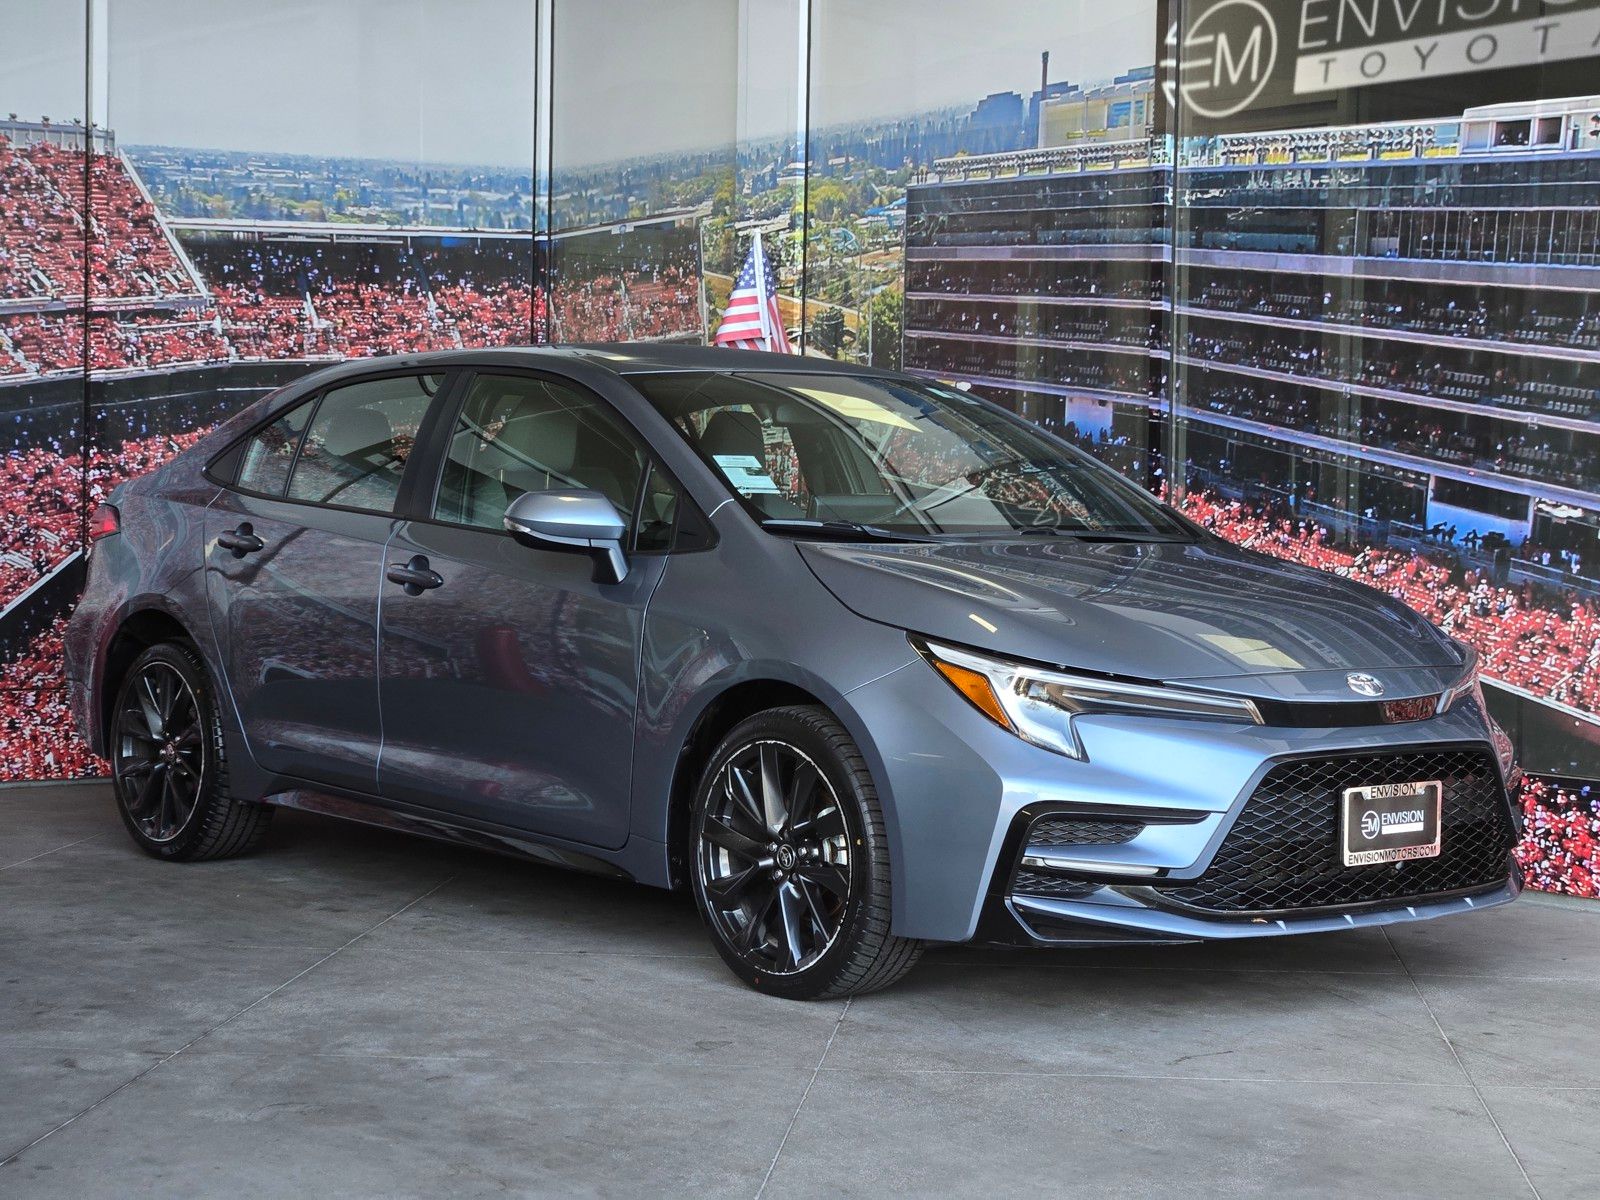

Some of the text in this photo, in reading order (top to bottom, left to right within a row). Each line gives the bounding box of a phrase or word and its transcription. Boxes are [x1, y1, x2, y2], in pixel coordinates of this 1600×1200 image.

[1298, 0, 1580, 49] ENVI
[1319, 22, 1600, 85] TOYOT
[1370, 783, 1417, 799] ENVISION
[1381, 809, 1424, 826] ENVISION
[1348, 845, 1437, 865] ENVISIONMOTORS.COM
